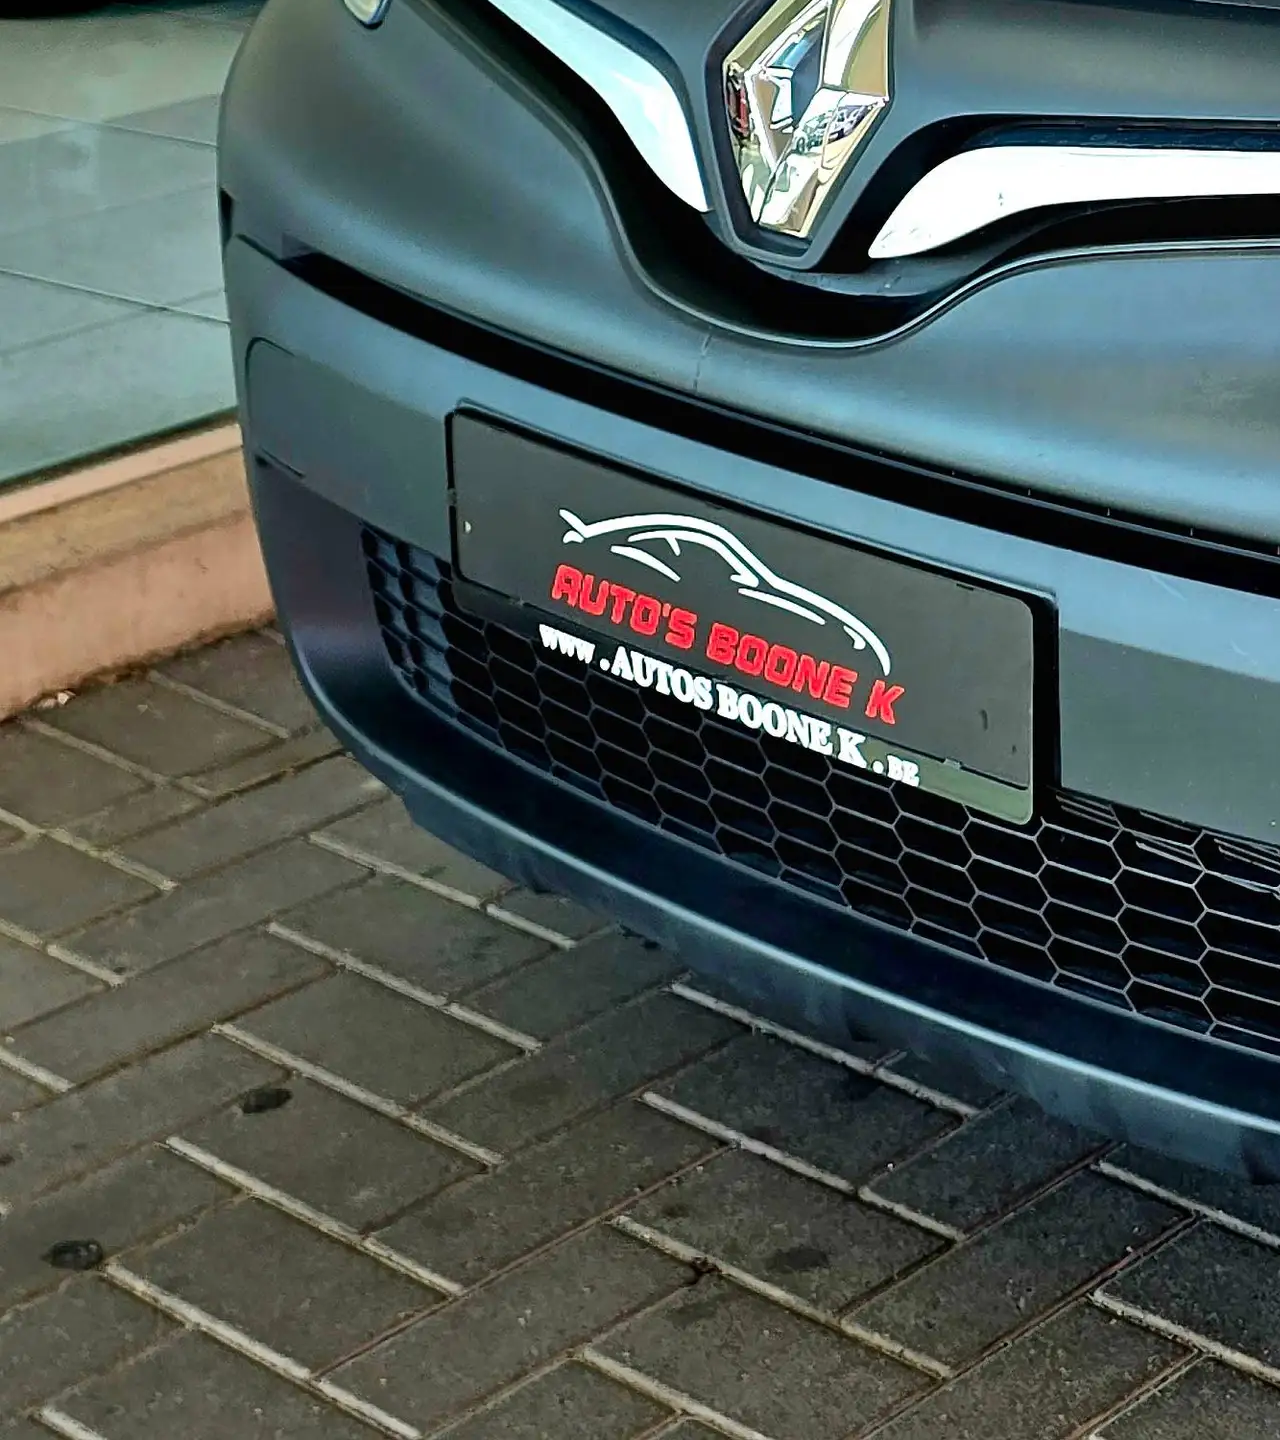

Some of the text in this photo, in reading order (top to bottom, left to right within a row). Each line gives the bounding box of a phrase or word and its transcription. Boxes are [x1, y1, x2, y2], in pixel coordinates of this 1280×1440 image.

[552, 564, 905, 725] AUTO'S BOONE K
